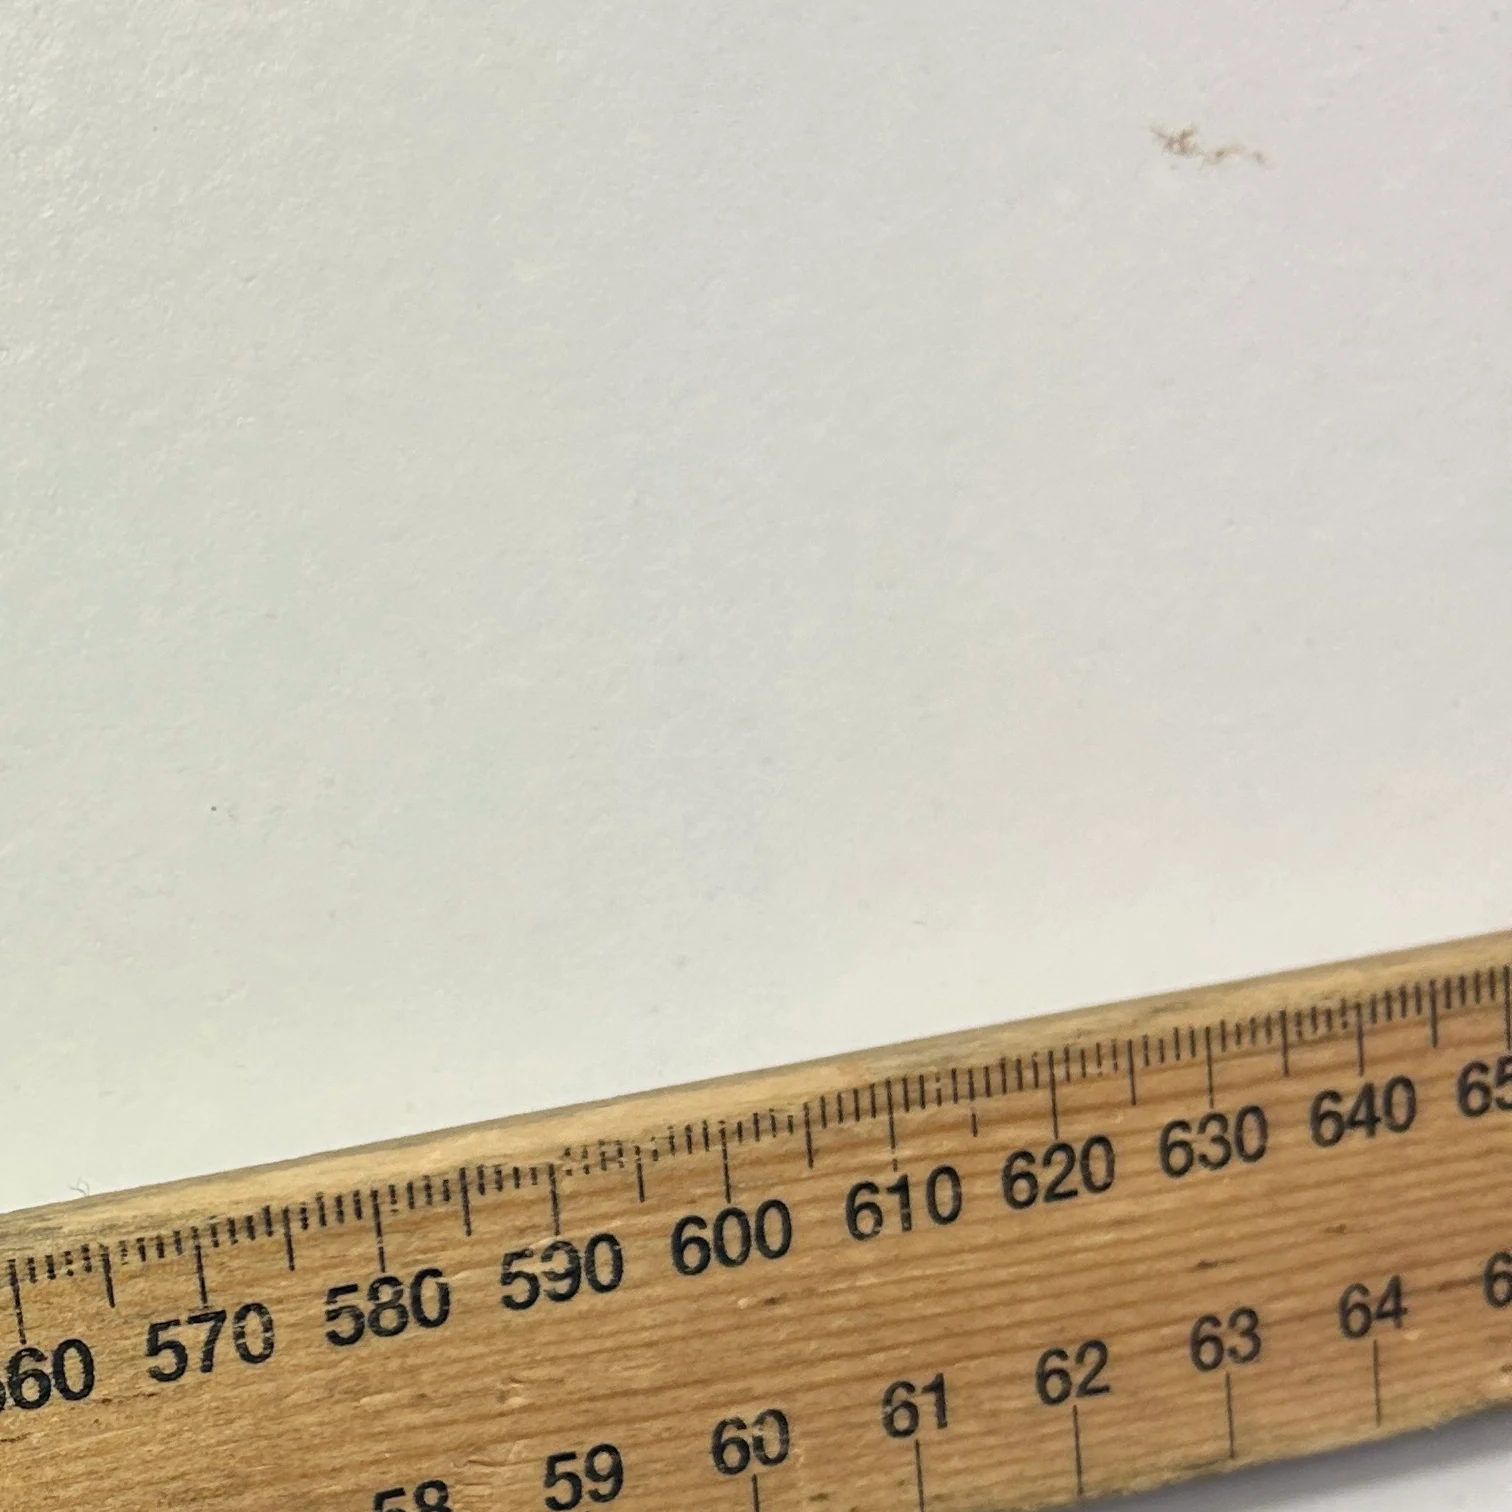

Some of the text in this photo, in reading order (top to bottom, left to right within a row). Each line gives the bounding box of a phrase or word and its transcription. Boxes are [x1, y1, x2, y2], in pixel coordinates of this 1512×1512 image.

[146, 1302, 276, 1382] 570
[324, 1268, 451, 1347] 580
[500, 1233, 624, 1311] 590
[671, 1199, 792, 1276] 600
[845, 1165, 963, 1241] 610
[1001, 1134, 1115, 1210] 620
[1159, 1104, 1269, 1178] 630
[1310, 1074, 1417, 1147] 640
[543, 1443, 624, 1512] 59
[710, 1408, 790, 1475] 60
[881, 1372, 949, 1437] 61
[1035, 1339, 1111, 1405] 62
[1189, 1307, 1262, 1372] 63
[1338, 1274, 1408, 1339] 64
